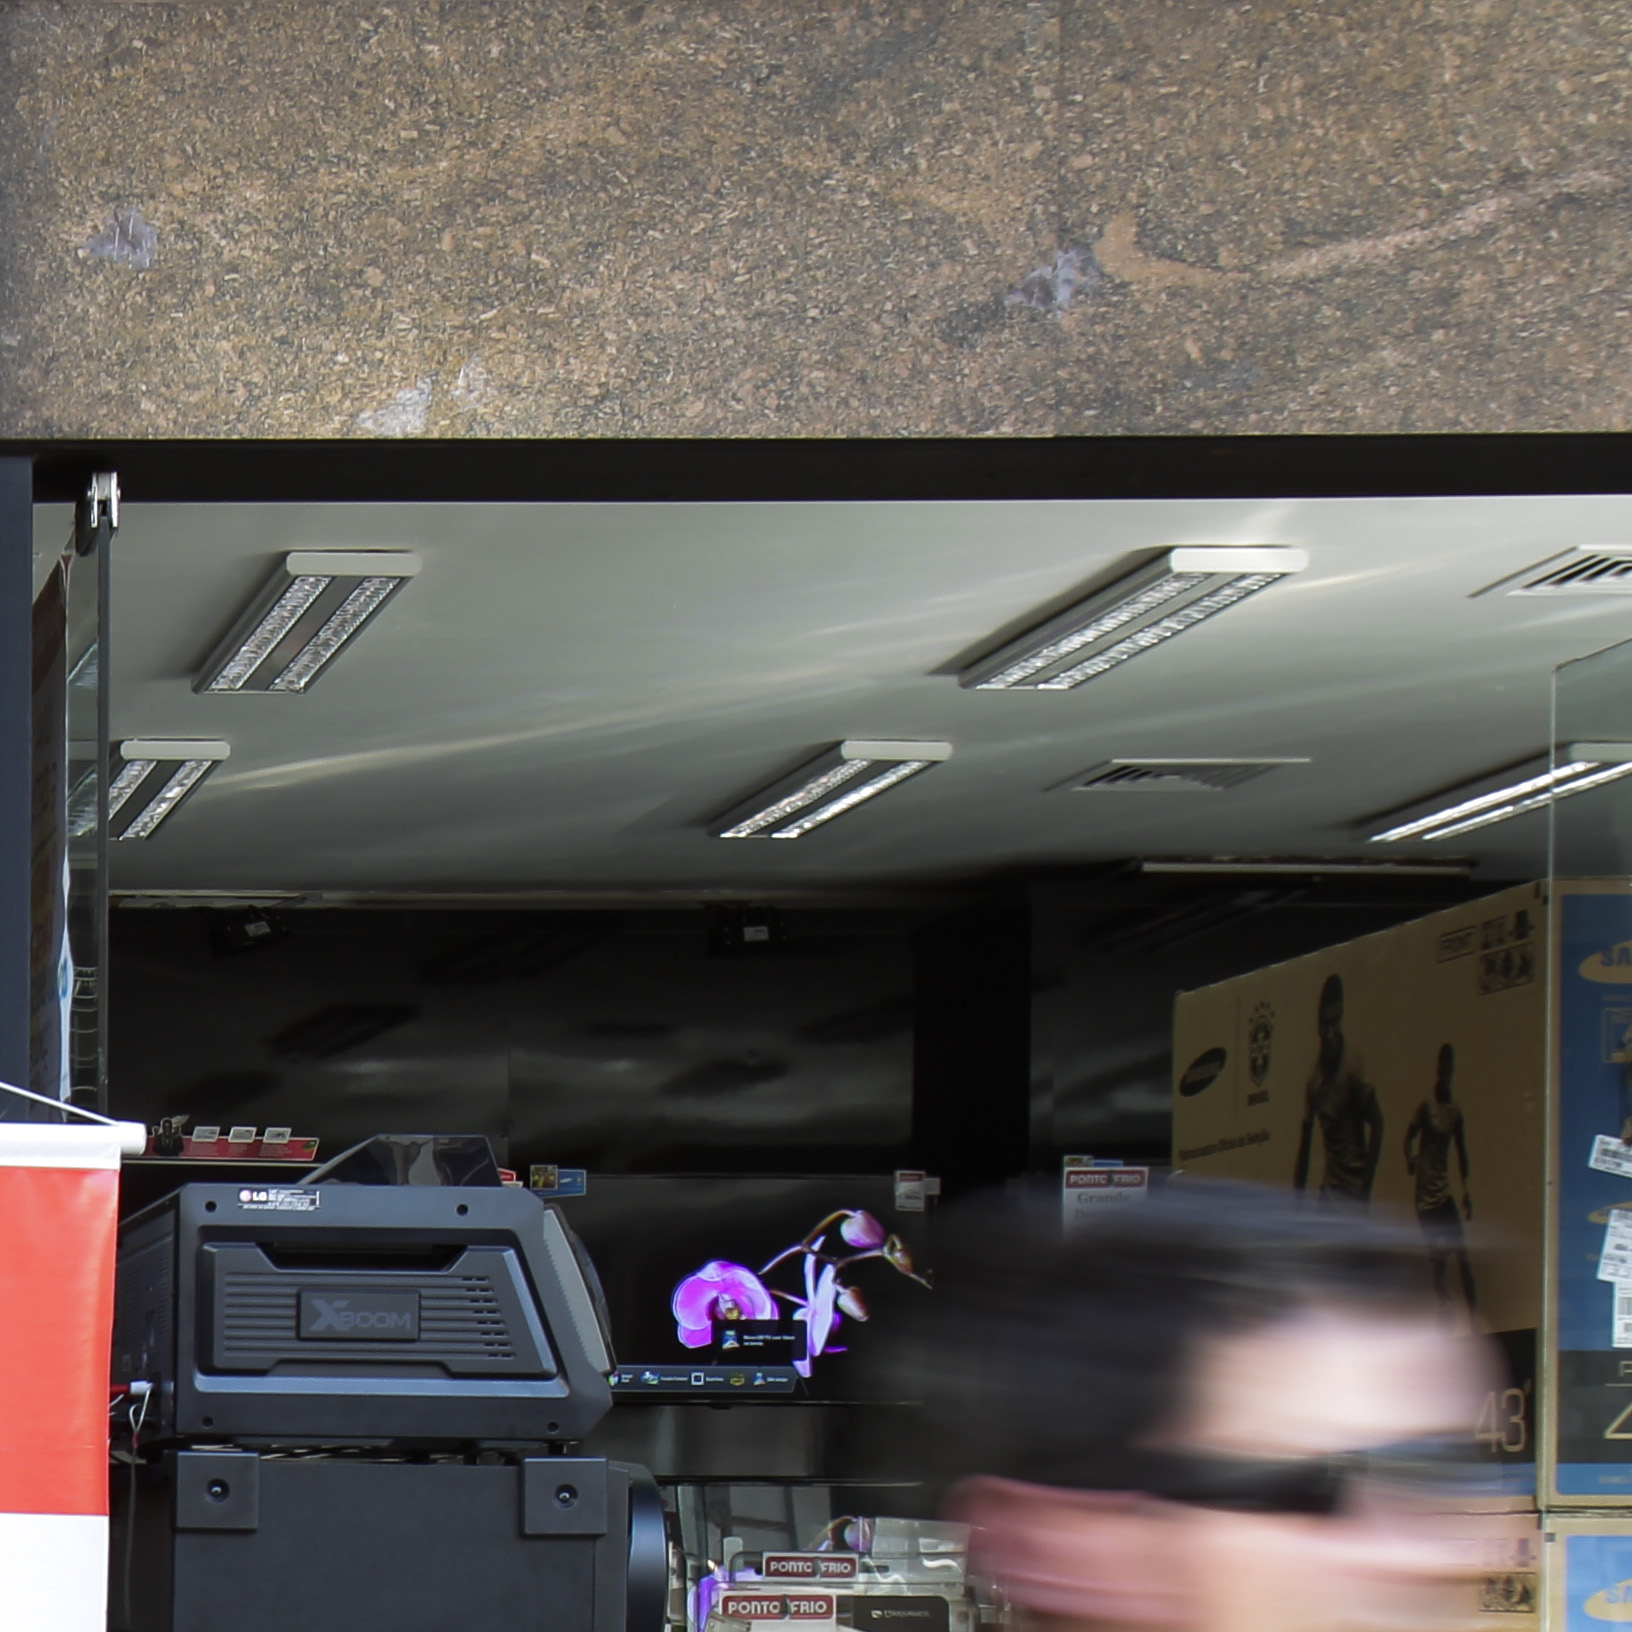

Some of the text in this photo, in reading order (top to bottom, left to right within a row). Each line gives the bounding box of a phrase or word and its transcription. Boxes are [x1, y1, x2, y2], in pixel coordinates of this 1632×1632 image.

[308, 1298, 412, 1333] XBOOM
[770, 1560, 852, 1574] PONTO FRIO
[728, 1601, 828, 1614] PONTO FRIO
